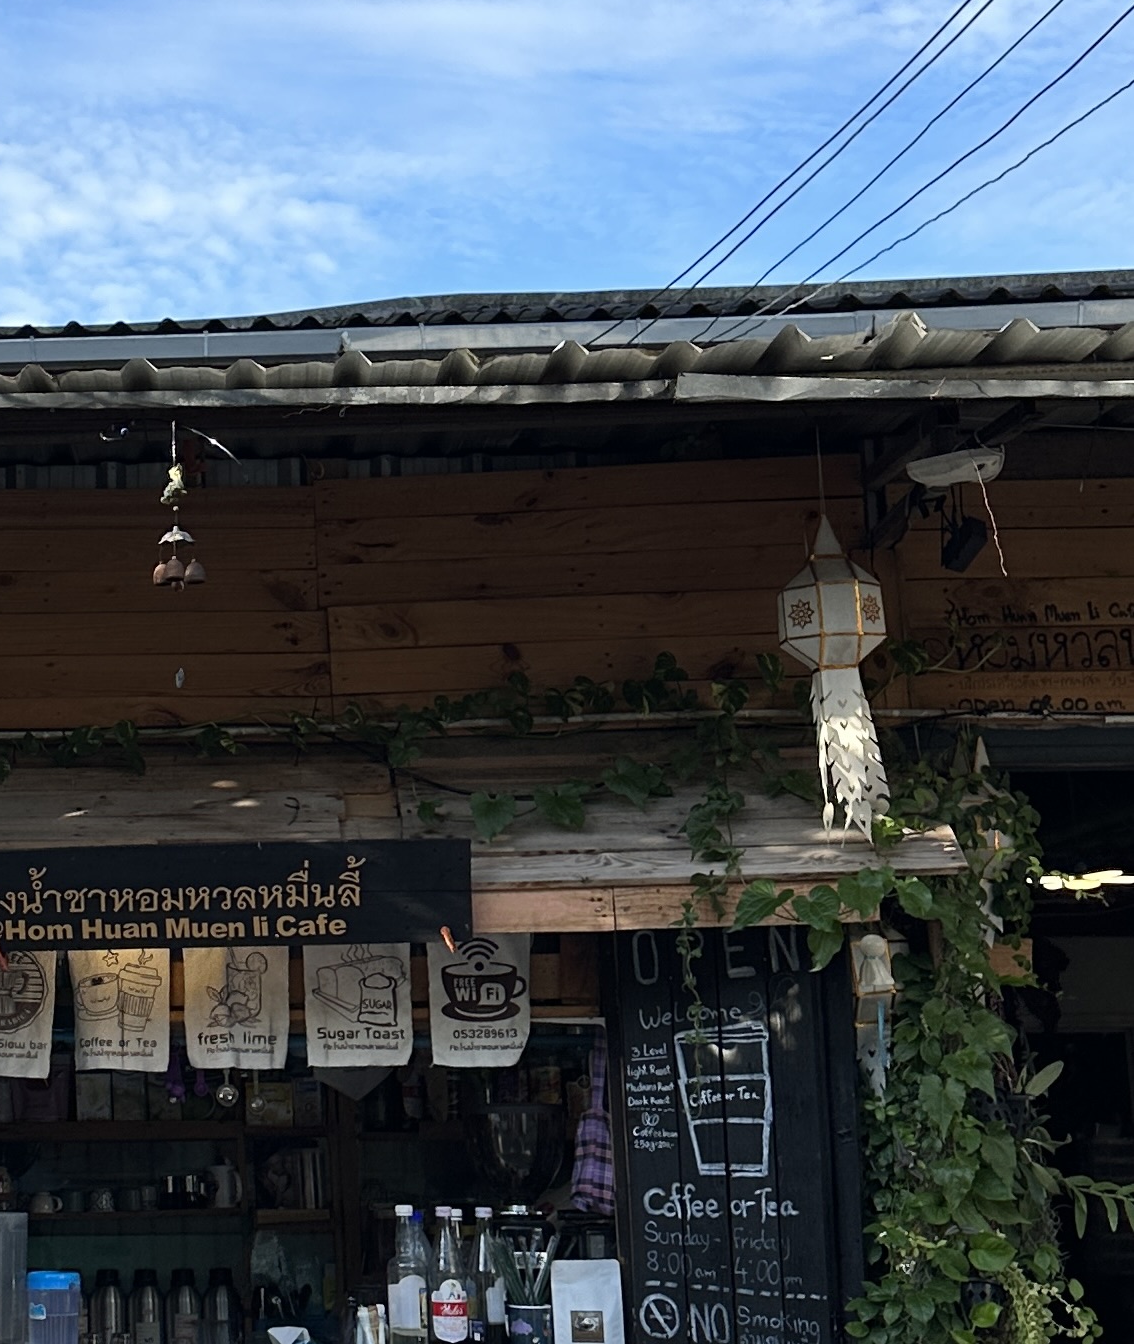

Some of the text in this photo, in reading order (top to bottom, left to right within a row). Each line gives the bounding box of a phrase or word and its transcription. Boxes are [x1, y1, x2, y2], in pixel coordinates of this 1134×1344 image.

[82, 916, 158, 941] Huan
[166, 916, 246, 941] Muen
[276, 912, 348, 938] Cafe
[79, 1037, 113, 1048] Coffee
[136, 1038, 158, 1048] Tea
[197, 1030, 277, 1045] fresh lime
[317, 1026, 405, 1041] Sugar Toast
[643, 1182, 800, 1224] Coffee or Tea
[689, 1302, 731, 1344] NO
